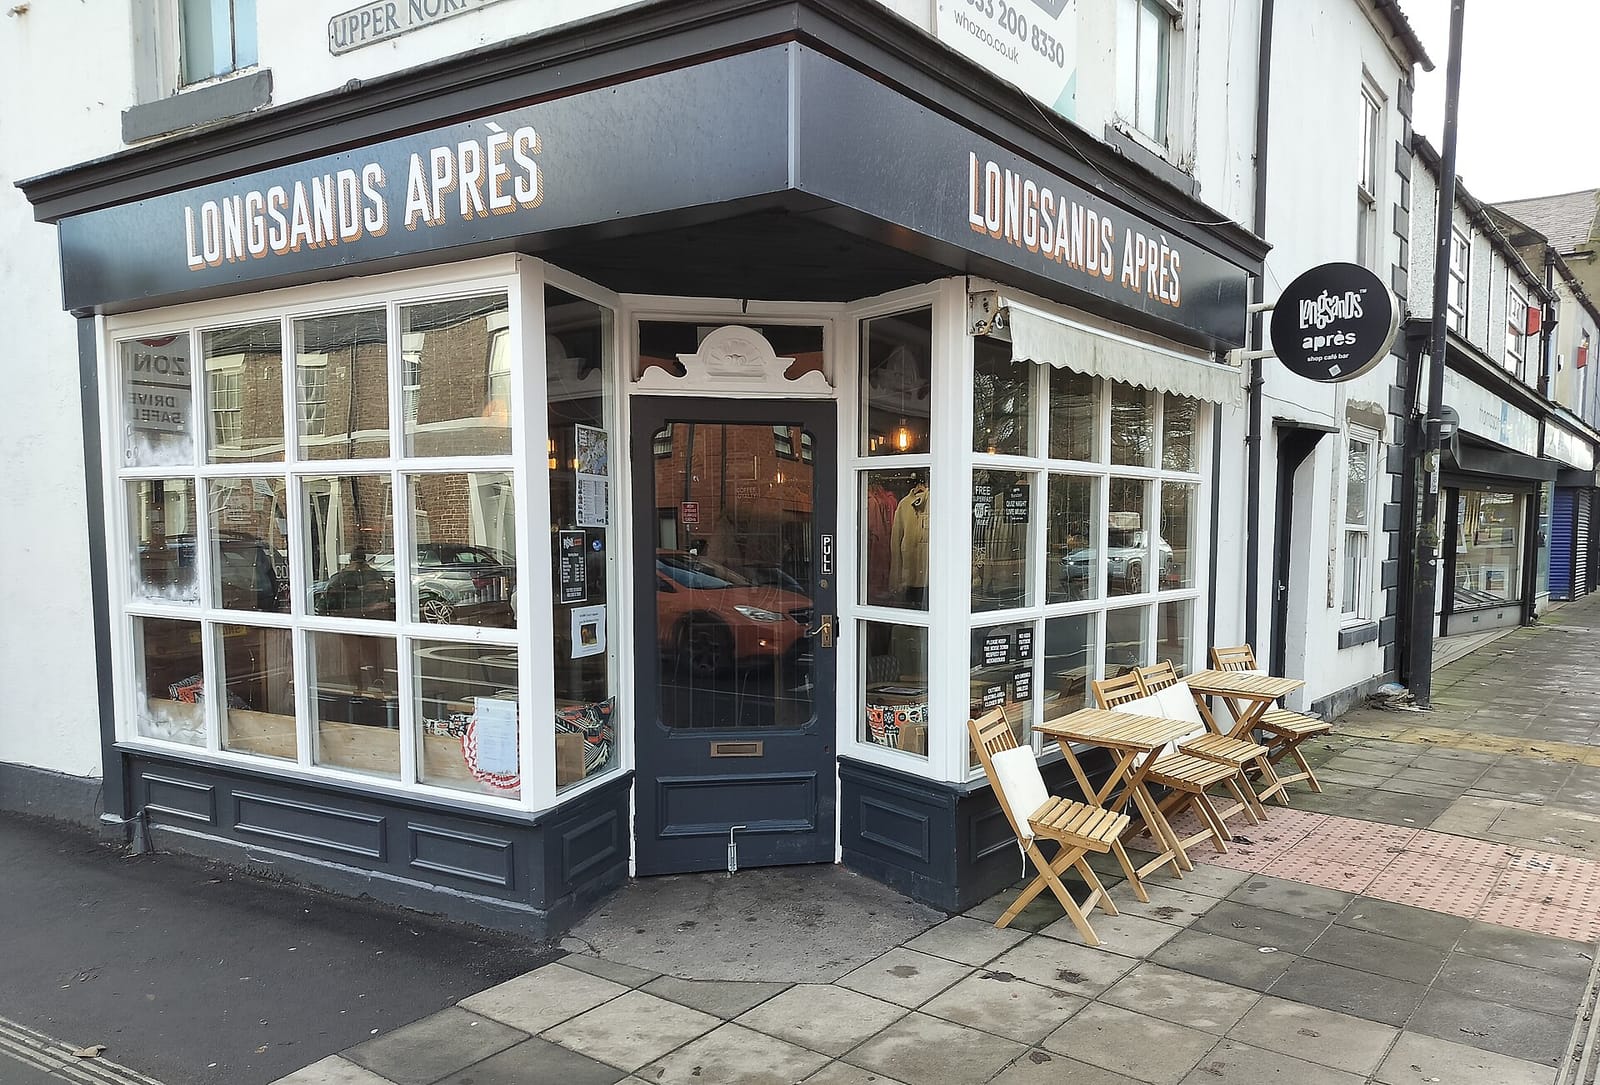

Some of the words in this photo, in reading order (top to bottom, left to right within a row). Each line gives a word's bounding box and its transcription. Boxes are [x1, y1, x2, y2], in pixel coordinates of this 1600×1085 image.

[333, 2, 400, 48] UPPER
[954, 10, 1019, 65] whozoo.co.uk
[998, 1, 1027, 42] 200
[1031, 24, 1064, 69] 8330
[184, 162, 388, 271] LONGSANDS
[403, 121, 544, 232] APRÈS
[968, 151, 1115, 282] LONGSANDS
[1121, 228, 1182, 308] APRÈS
[1302, 331, 1357, 352] après
[975, 485, 991, 496] FREE
[823, 536, 831, 572] PULL
